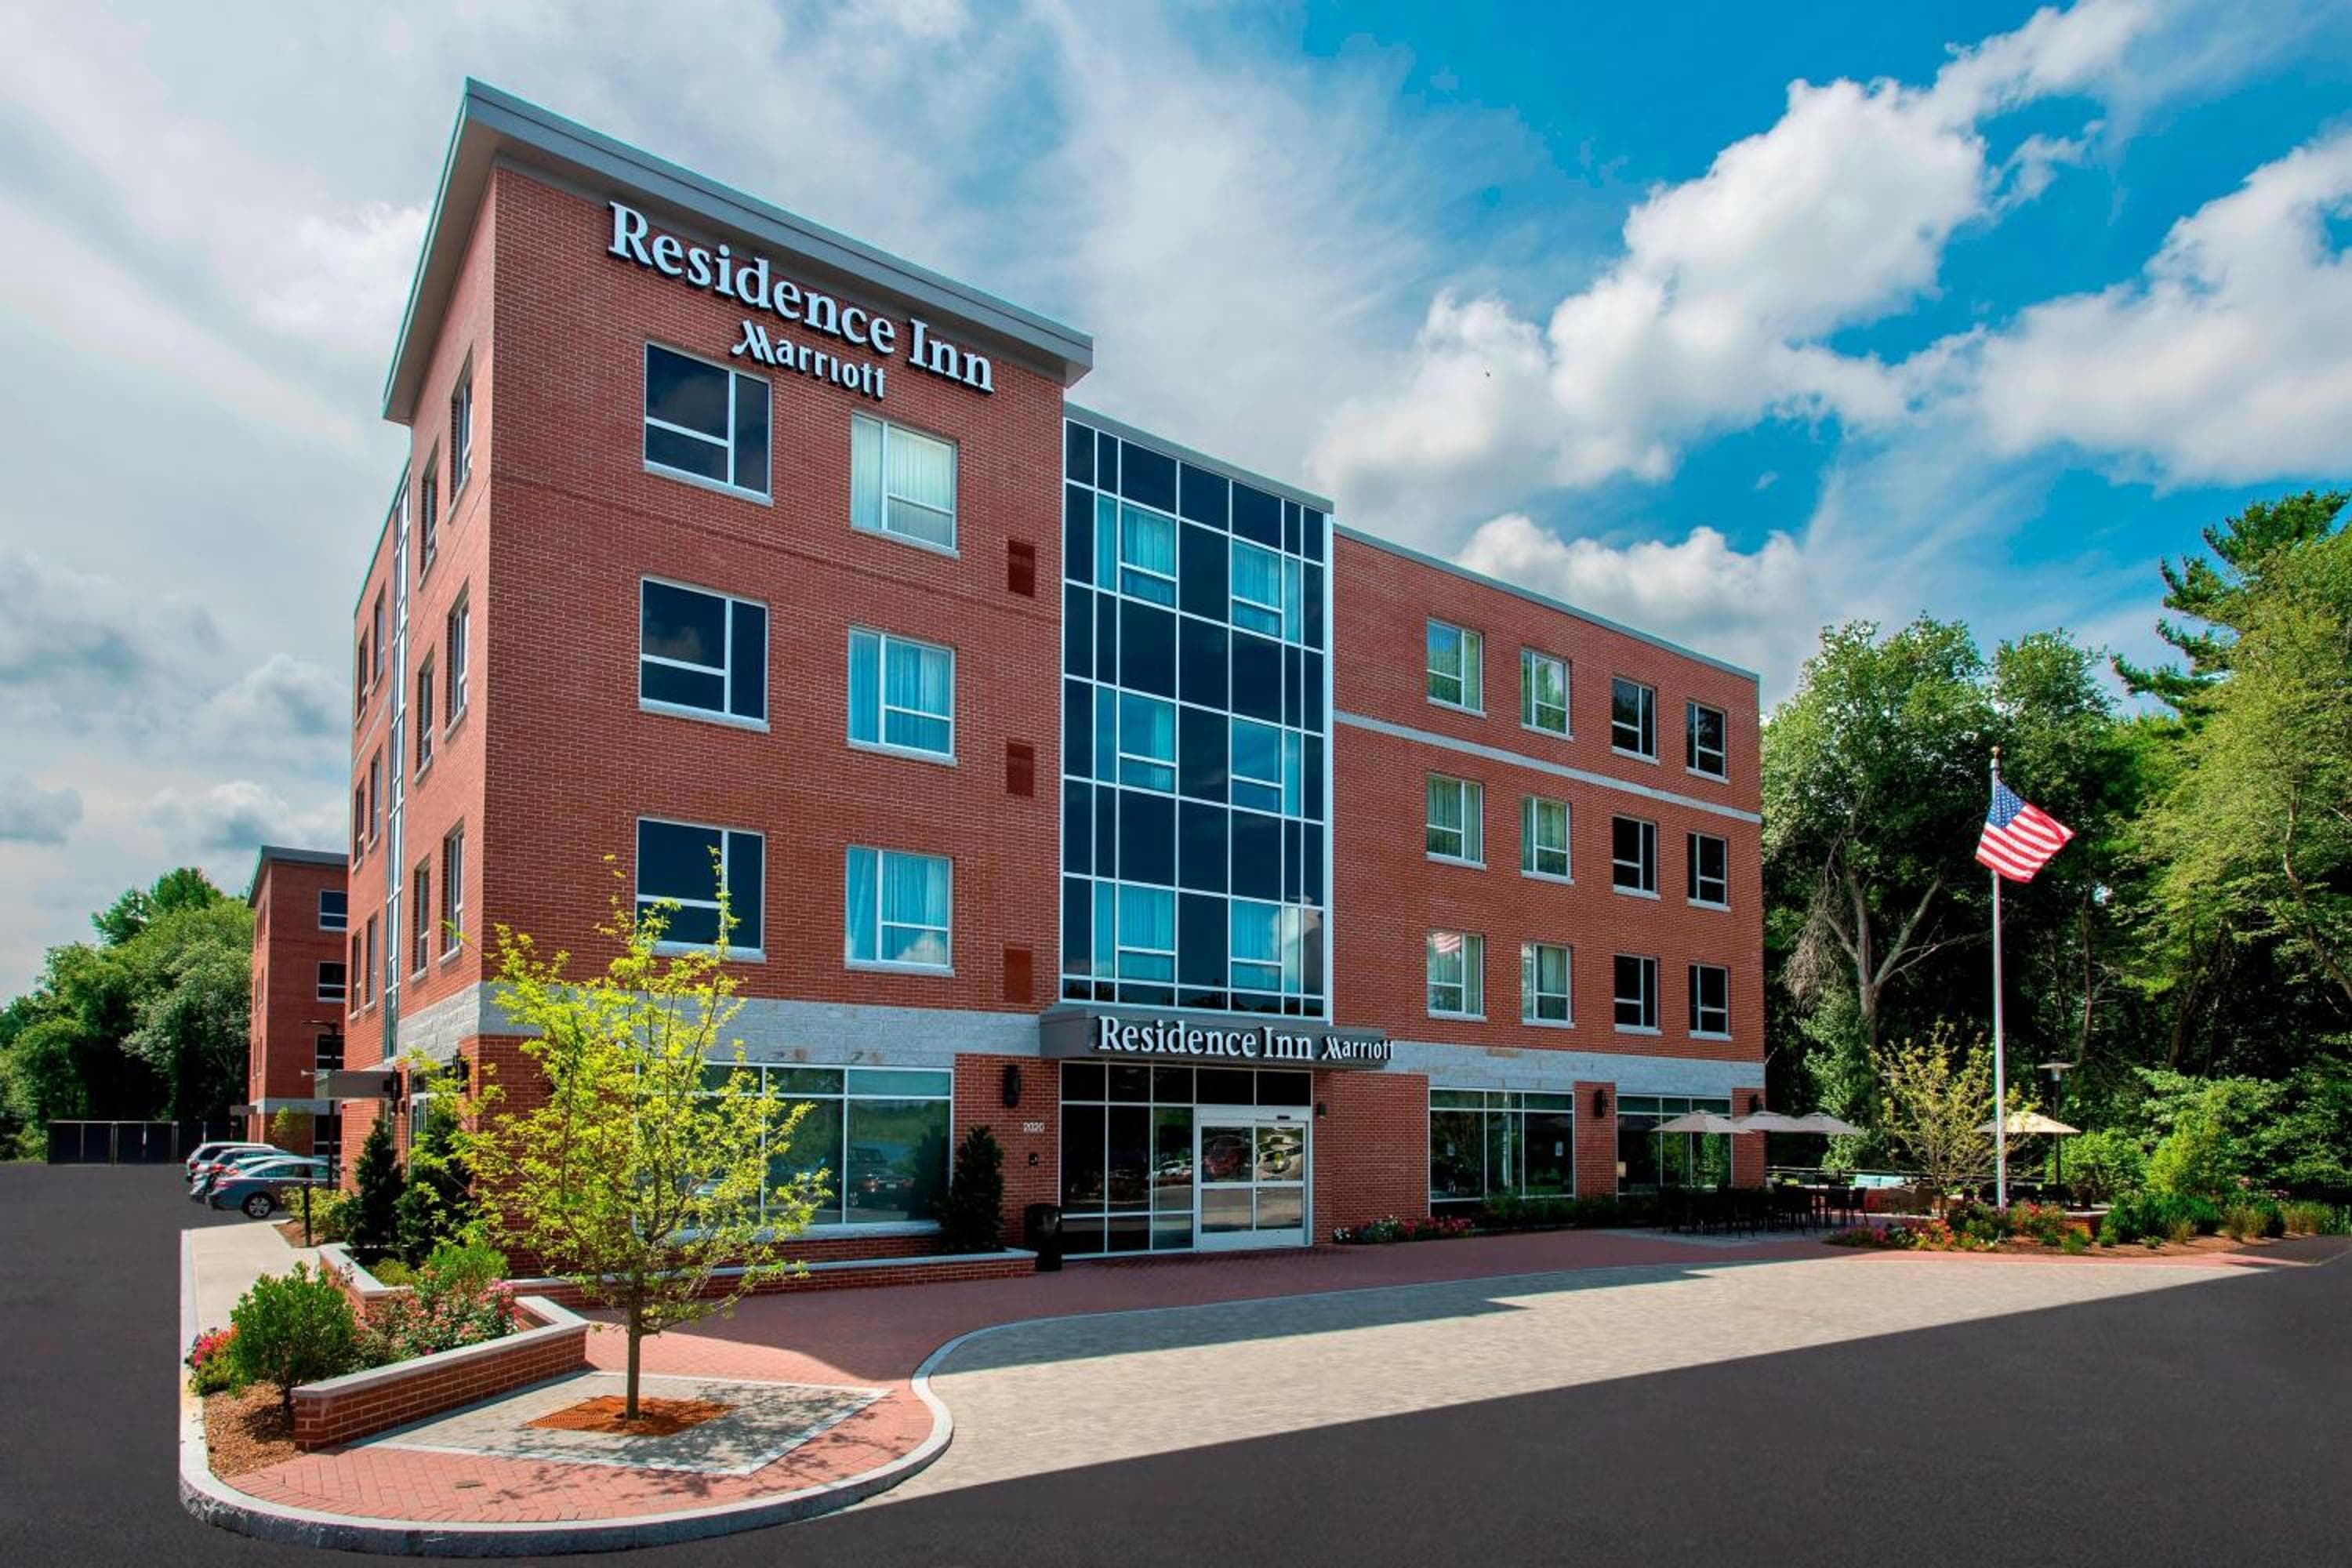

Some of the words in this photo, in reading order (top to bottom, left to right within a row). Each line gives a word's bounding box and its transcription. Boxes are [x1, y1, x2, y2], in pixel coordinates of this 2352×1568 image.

[608, 200, 895, 354] Residence
[908, 318, 995, 393] Inn
[731, 319, 886, 398] Marriott
[1098, 1016, 1257, 1056] Residence
[1263, 1026, 1314, 1060] Inn
[1321, 1036, 1393, 1060] Marriott
